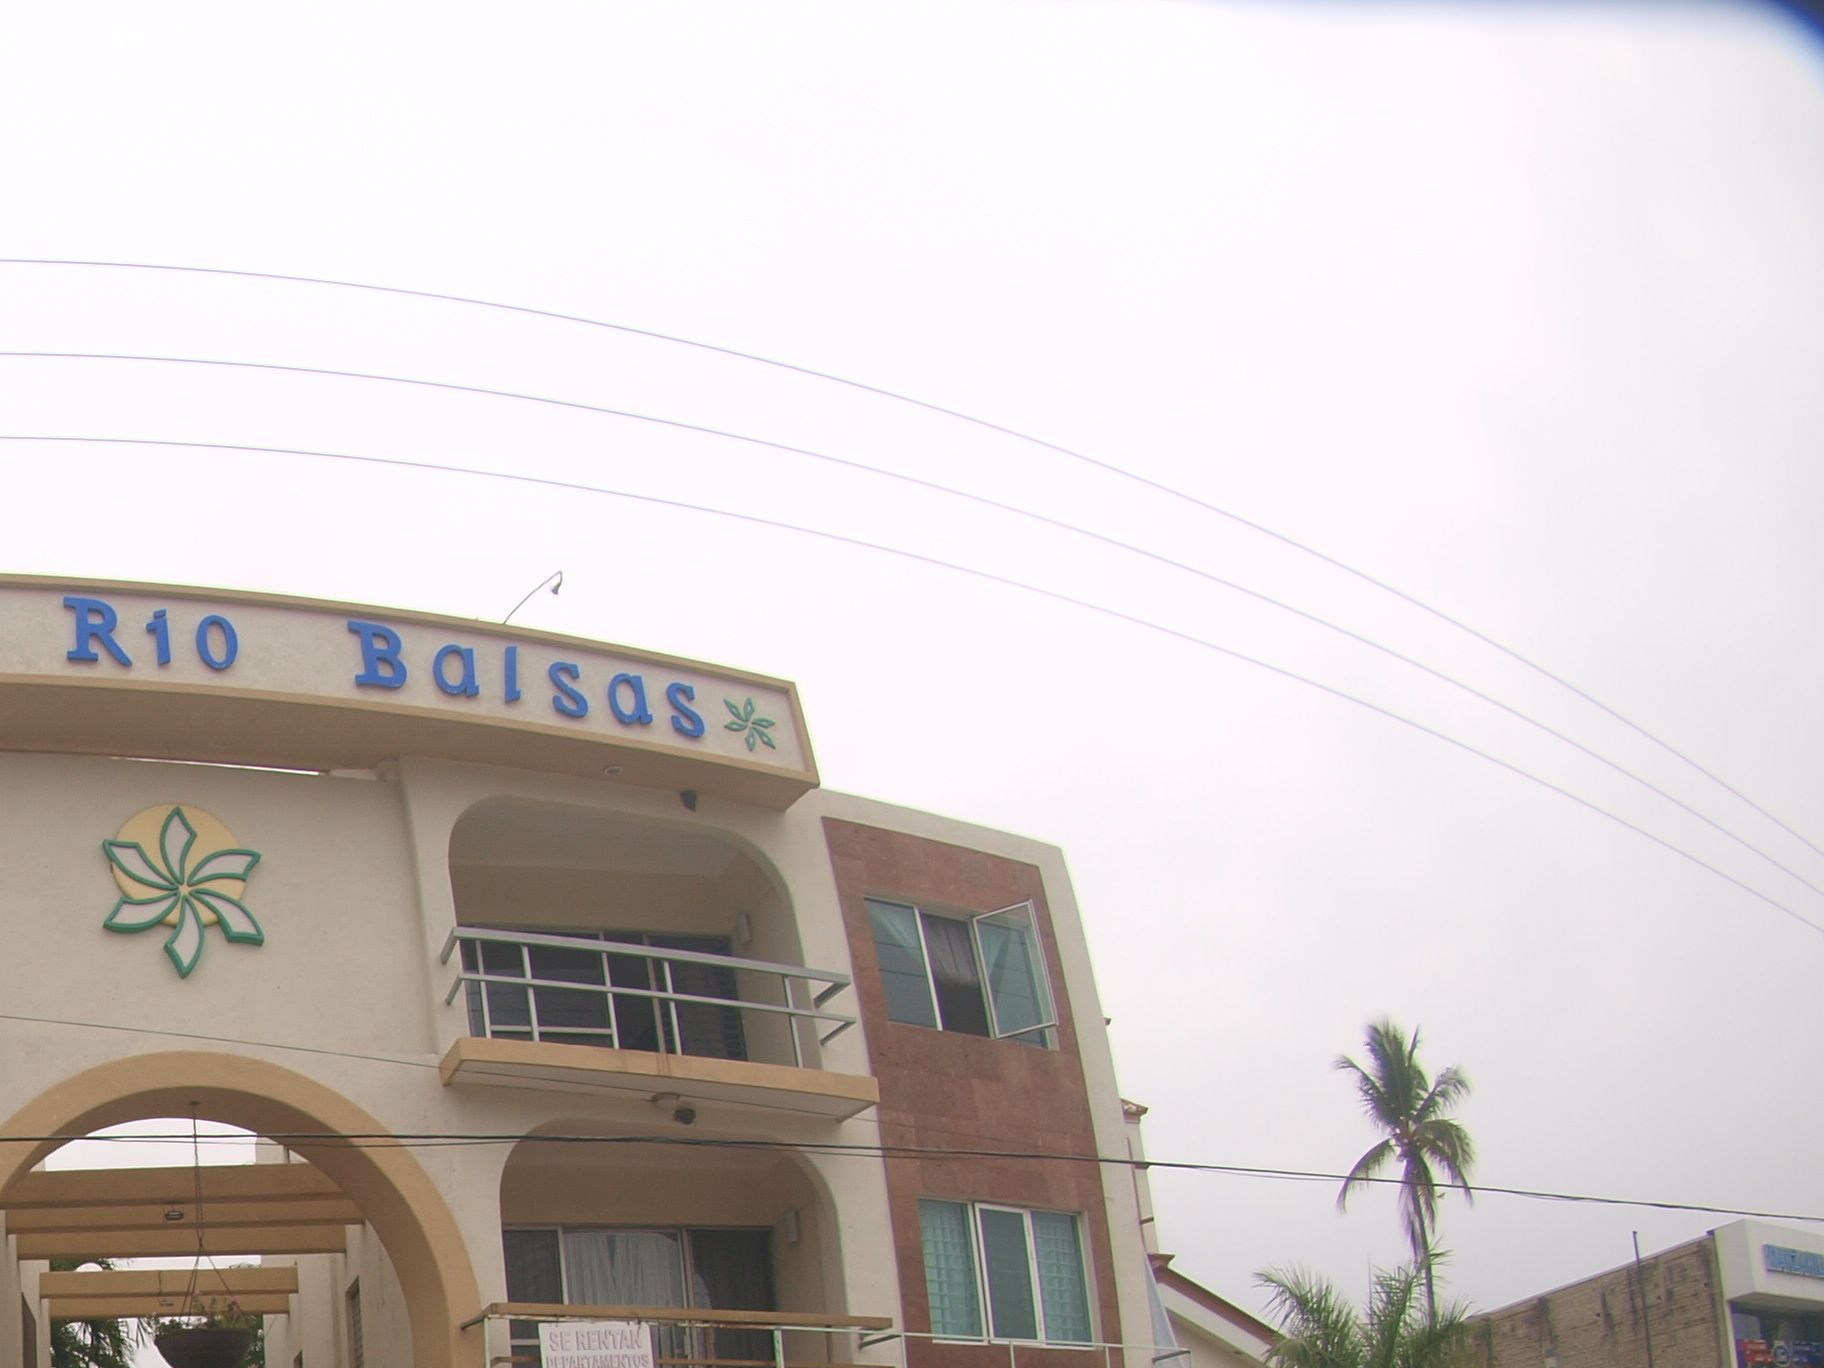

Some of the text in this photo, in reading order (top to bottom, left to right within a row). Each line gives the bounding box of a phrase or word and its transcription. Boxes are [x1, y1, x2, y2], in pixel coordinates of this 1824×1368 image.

[347, 619, 706, 738] Balsas
[549, 1329, 642, 1351] SE RENTAN
